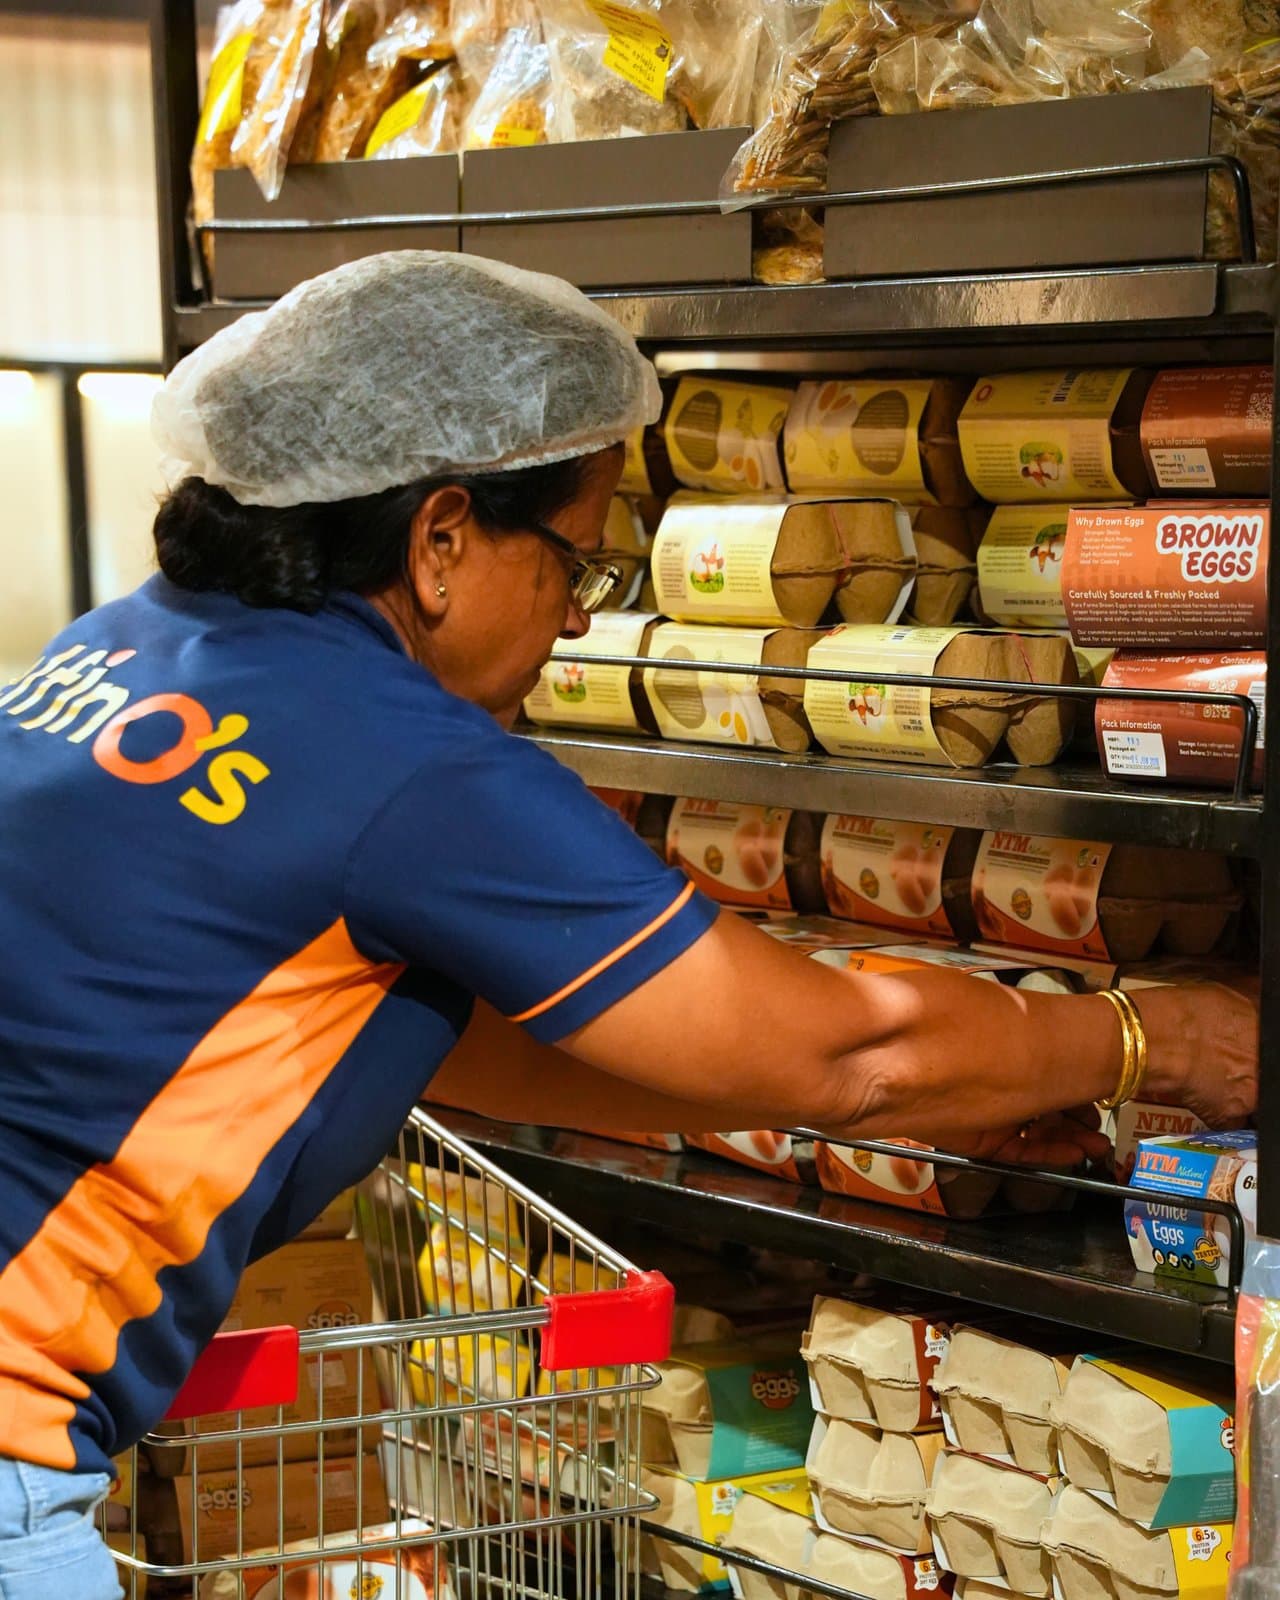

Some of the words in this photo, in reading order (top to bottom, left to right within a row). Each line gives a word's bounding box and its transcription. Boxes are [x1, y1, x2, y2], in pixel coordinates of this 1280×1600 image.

[1075, 517, 1094, 528] Why
[1096, 516, 1122, 526] Brown
[1124, 516, 1145, 528] Eggs
[1160, 522, 1259, 550] BROWN
[1186, 550, 1254, 578] EGGS
[1068, 590, 1108, 600] Carefully
[1110, 590, 1144, 600] Sourced
[1146, 590, 1152, 600] &
[1154, 590, 1186, 601] Freshly
[1188, 590, 1220, 600] Packed
[1220, 656, 1250, 664] Contact
[1101, 719, 1118, 728] Pack
[1120, 720, 1162, 731] Information
[990, 832, 1032, 854] NTM
[1135, 1111, 1195, 1136] NTM
[1138, 1151, 1180, 1174] NTM
[1177, 1165, 1208, 1180] Natural
[1152, 1220, 1185, 1247] Eggs
[1195, 1248, 1220, 1260] TESTED
[751, 1378, 801, 1400] eggs
[198, 1488, 252, 1512] eggs
